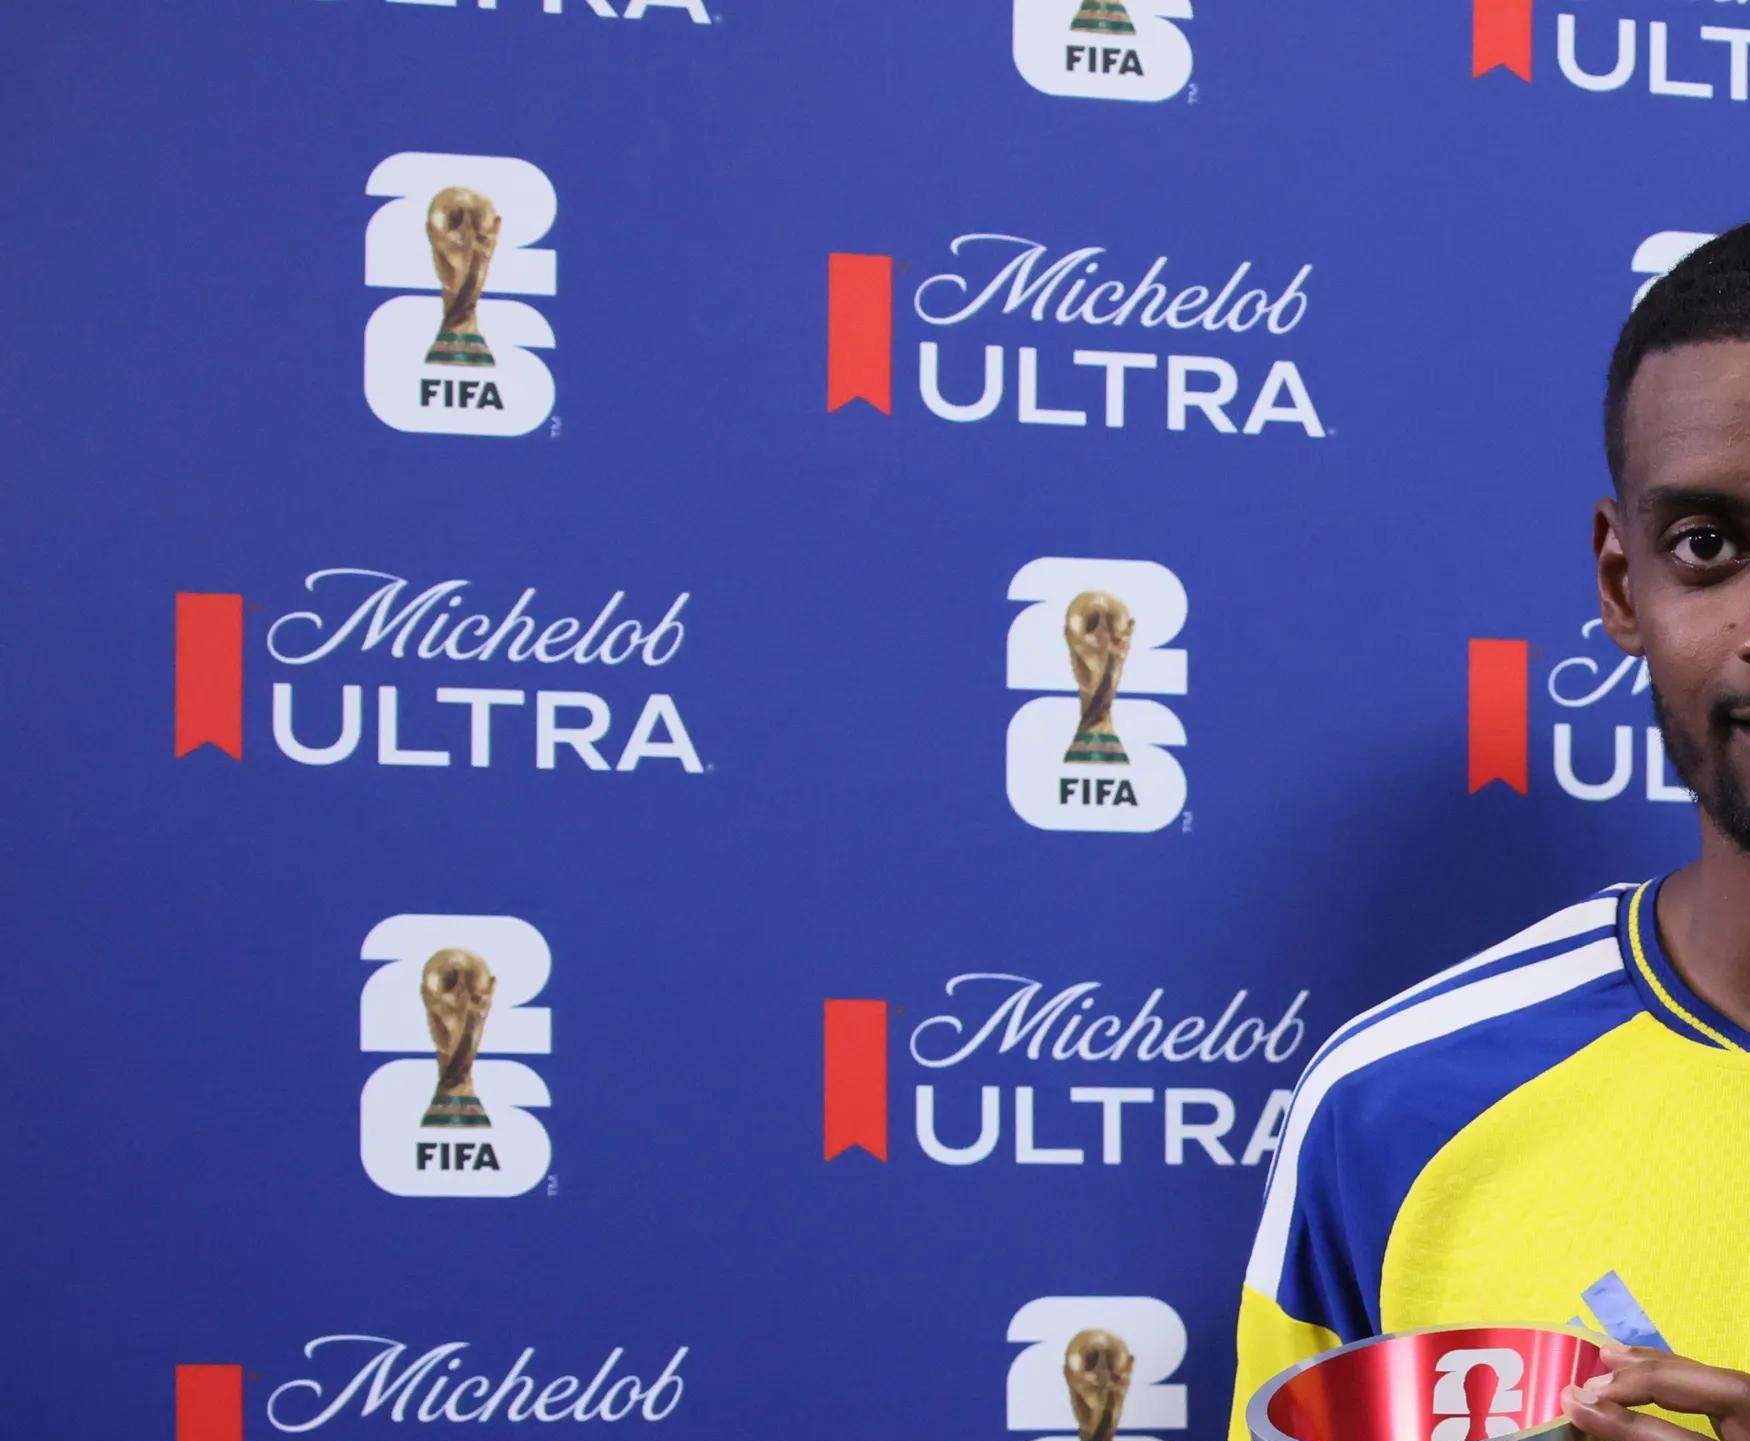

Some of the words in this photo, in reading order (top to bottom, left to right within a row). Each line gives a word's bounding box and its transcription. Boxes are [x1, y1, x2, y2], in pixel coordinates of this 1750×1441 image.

[1065, 44, 1145, 77] FIFA
[913, 232, 1313, 335] Michelob
[420, 378, 505, 411] FIFA
[918, 340, 1327, 438] ULTRA
[266, 567, 691, 667] Michelob
[272, 682, 705, 774] ULTRA
[1059, 777, 1139, 807] FIFA
[908, 972, 1310, 1069] Michelob
[416, 1141, 501, 1172] FIFA
[915, 1083, 1294, 1167] ULTRA
[266, 1334, 690, 1433] Michelob
